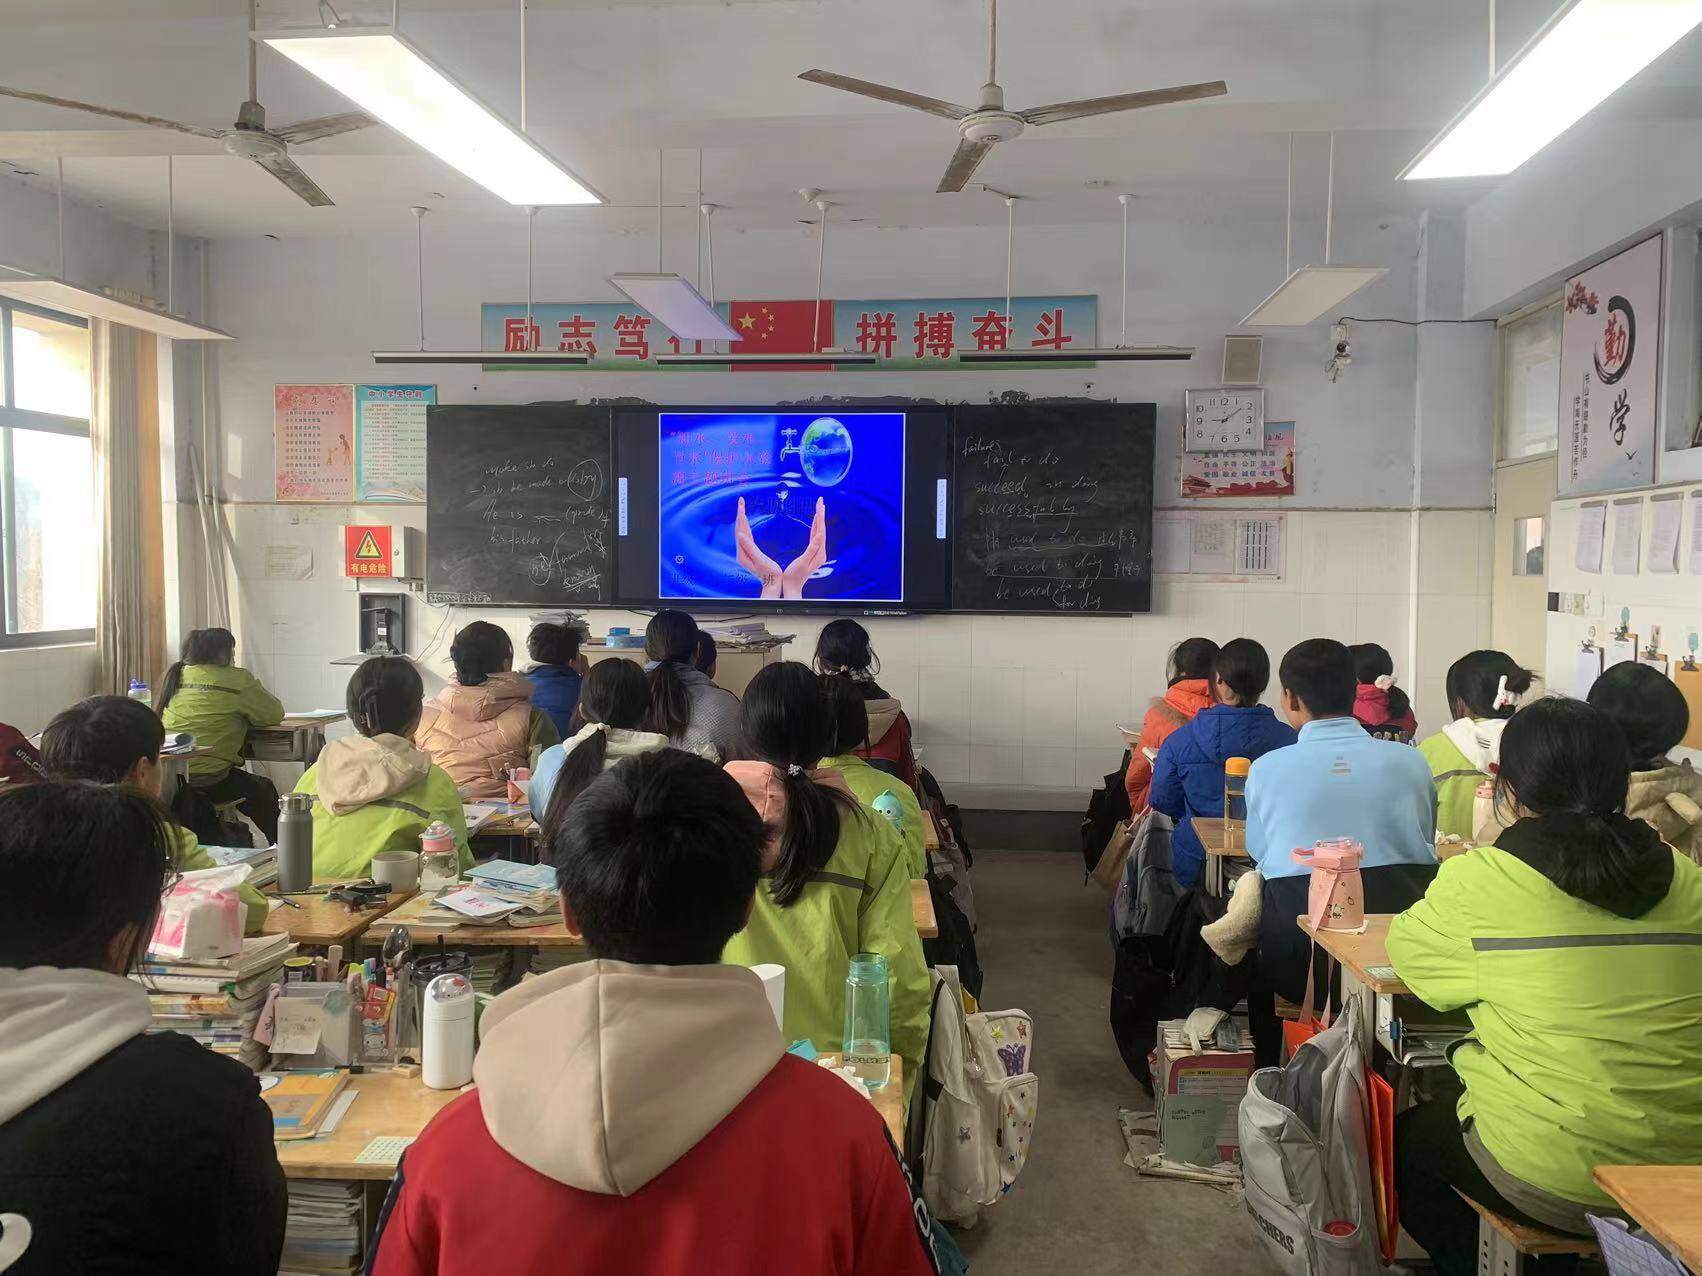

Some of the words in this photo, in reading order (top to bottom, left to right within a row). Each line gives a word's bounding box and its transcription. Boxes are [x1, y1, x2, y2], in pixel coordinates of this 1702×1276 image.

[856, 309, 1073, 359] 拼搏奋斗
[1221, 398, 1229, 406] 12
[1246, 402, 1253, 410] 2
[1196, 417, 1203, 425] 9
[1246, 416, 1252, 424] 3
[1221, 435, 1228, 443] 6
[1234, 435, 1240, 443] 5
[351, 563, 387, 574] 有电危险
